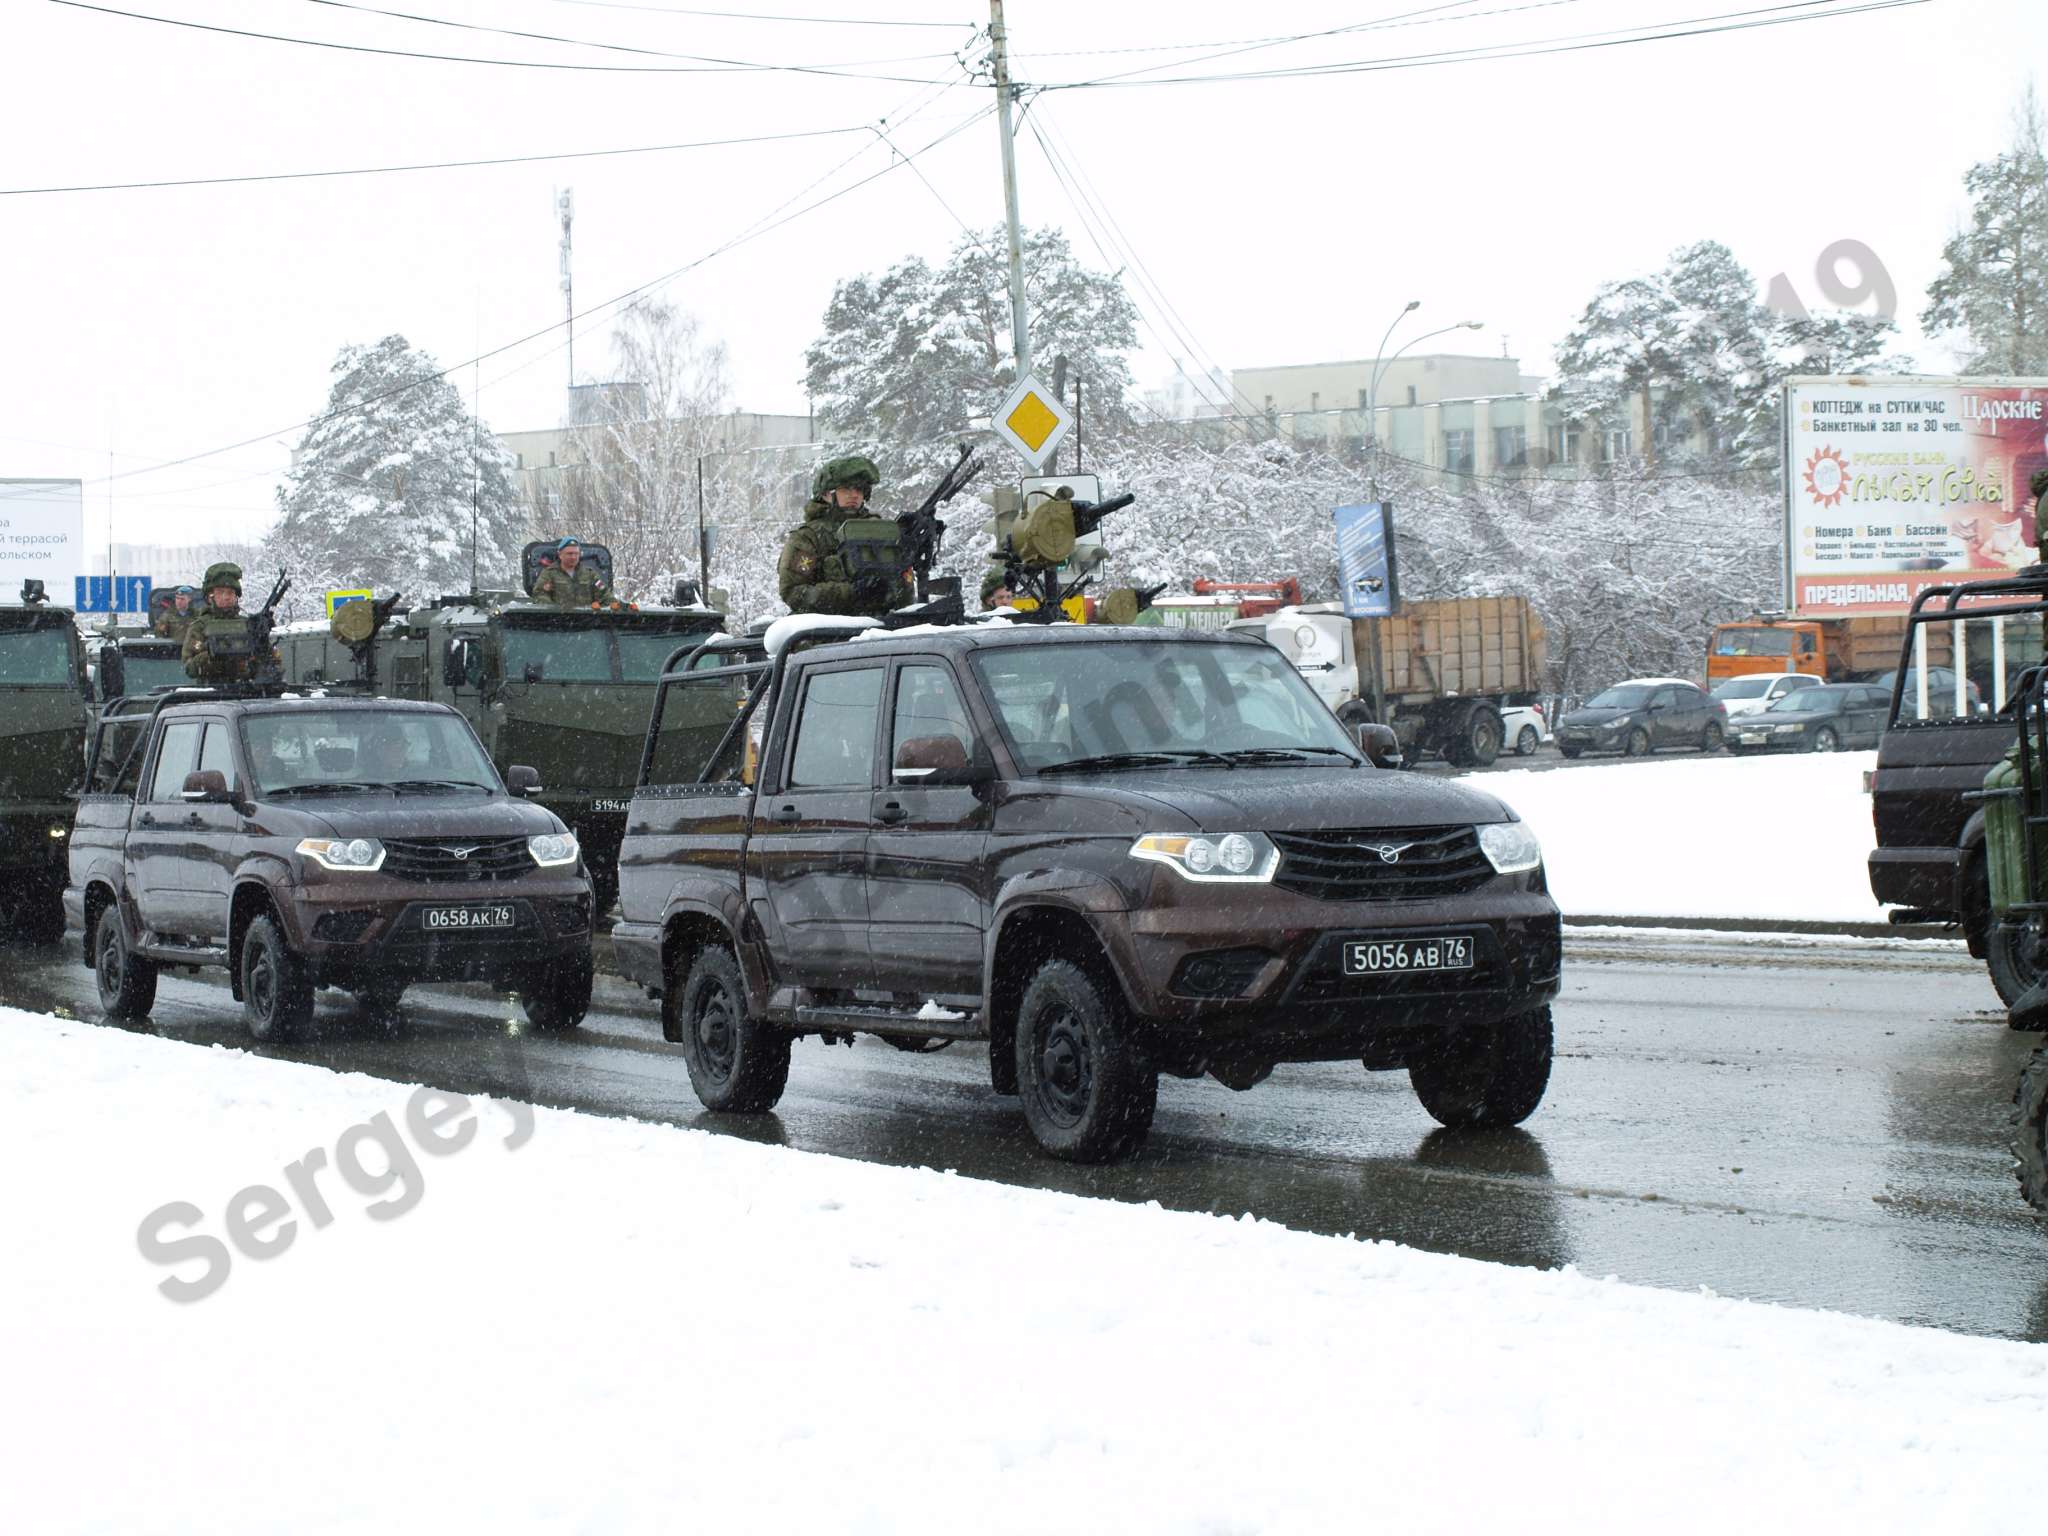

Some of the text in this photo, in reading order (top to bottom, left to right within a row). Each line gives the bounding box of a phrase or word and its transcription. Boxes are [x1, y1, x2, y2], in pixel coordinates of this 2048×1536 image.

[1812, 400, 1864, 414] КОТТЕДЖ
[1868, 402, 1882, 413] на
[1961, 395, 2043, 435] Царские
[1812, 418, 1964, 432] Банкетный зал на 30 чел.
[9, 533, 68, 544] террасой
[1815, 524, 1948, 539] Номера Баня Бассейн
[1805, 583, 1912, 606] ПРЕДЕЛЬНАЯ,
[1164, 612, 1186, 628] МЫ
[595, 800, 619, 811] 5194
[429, 910, 469, 927] 0658
[494, 907, 509, 920] 76
[1354, 943, 1409, 970] 5056
[1445, 939, 1466, 959] 76
